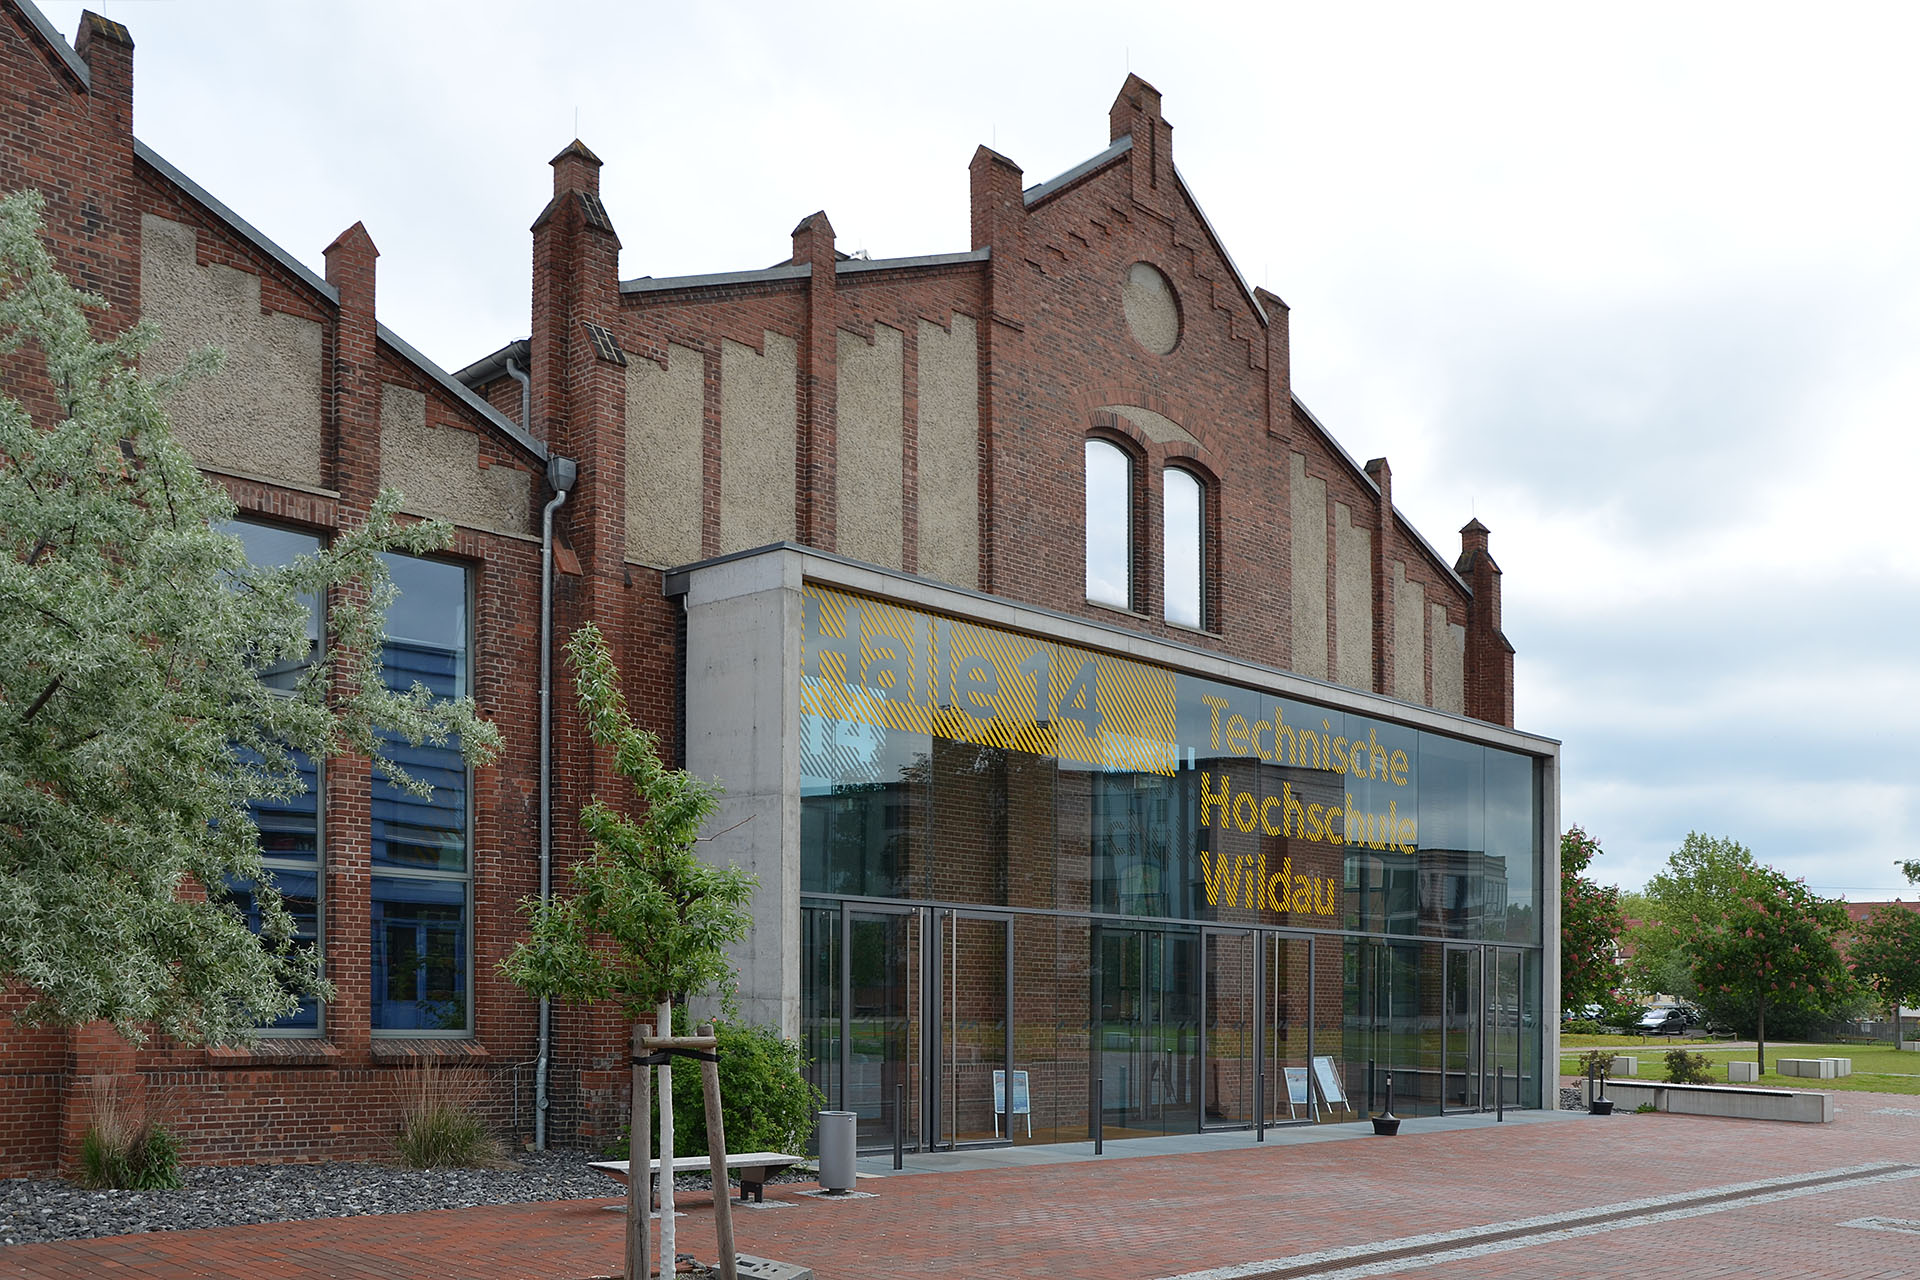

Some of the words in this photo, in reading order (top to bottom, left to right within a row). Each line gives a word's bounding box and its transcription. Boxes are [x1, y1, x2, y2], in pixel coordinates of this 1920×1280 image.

[1201, 694, 1409, 786] Technische
[1200, 771, 1417, 854] Hochschule
[1200, 850, 1335, 916] Wildau
